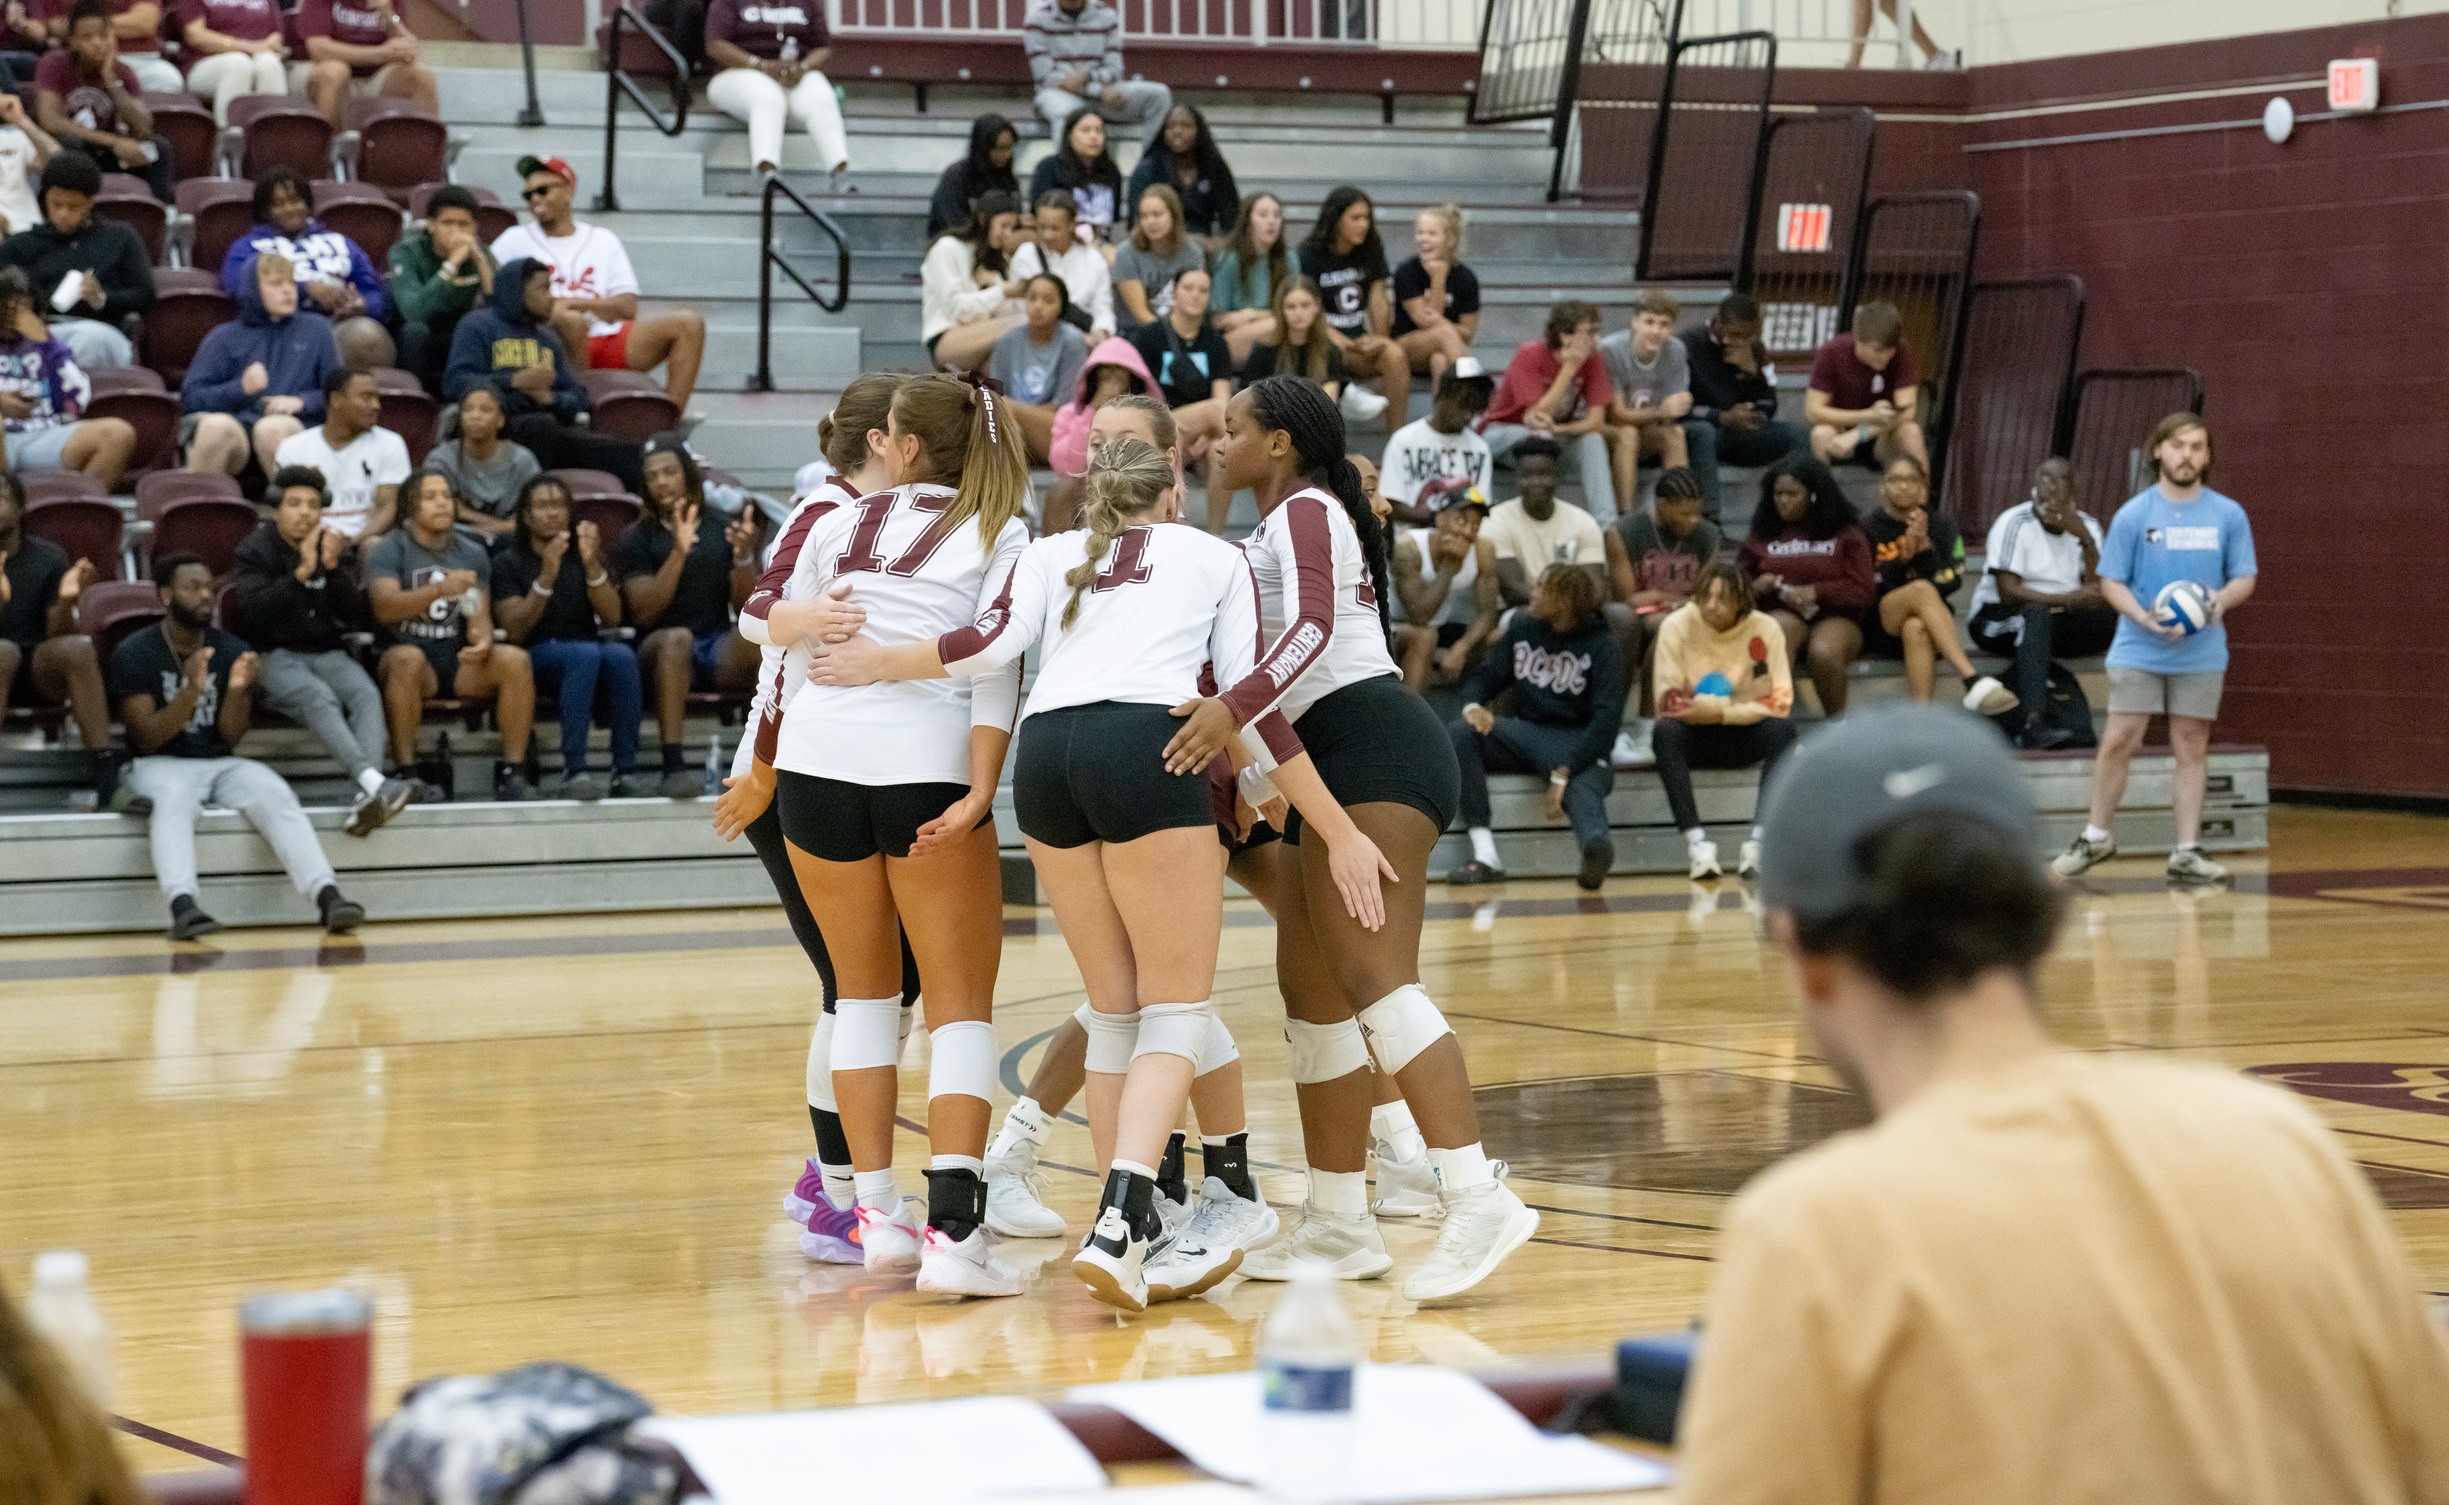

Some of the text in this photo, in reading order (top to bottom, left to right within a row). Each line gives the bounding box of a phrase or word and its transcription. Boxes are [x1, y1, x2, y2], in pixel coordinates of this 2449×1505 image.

[1340, 286, 1360, 311] C
[979, 386, 997, 444] LADIES
[833, 491, 976, 578] 17
[1091, 525, 1153, 594] 1
[1264, 621, 1325, 690] CENTENARY
